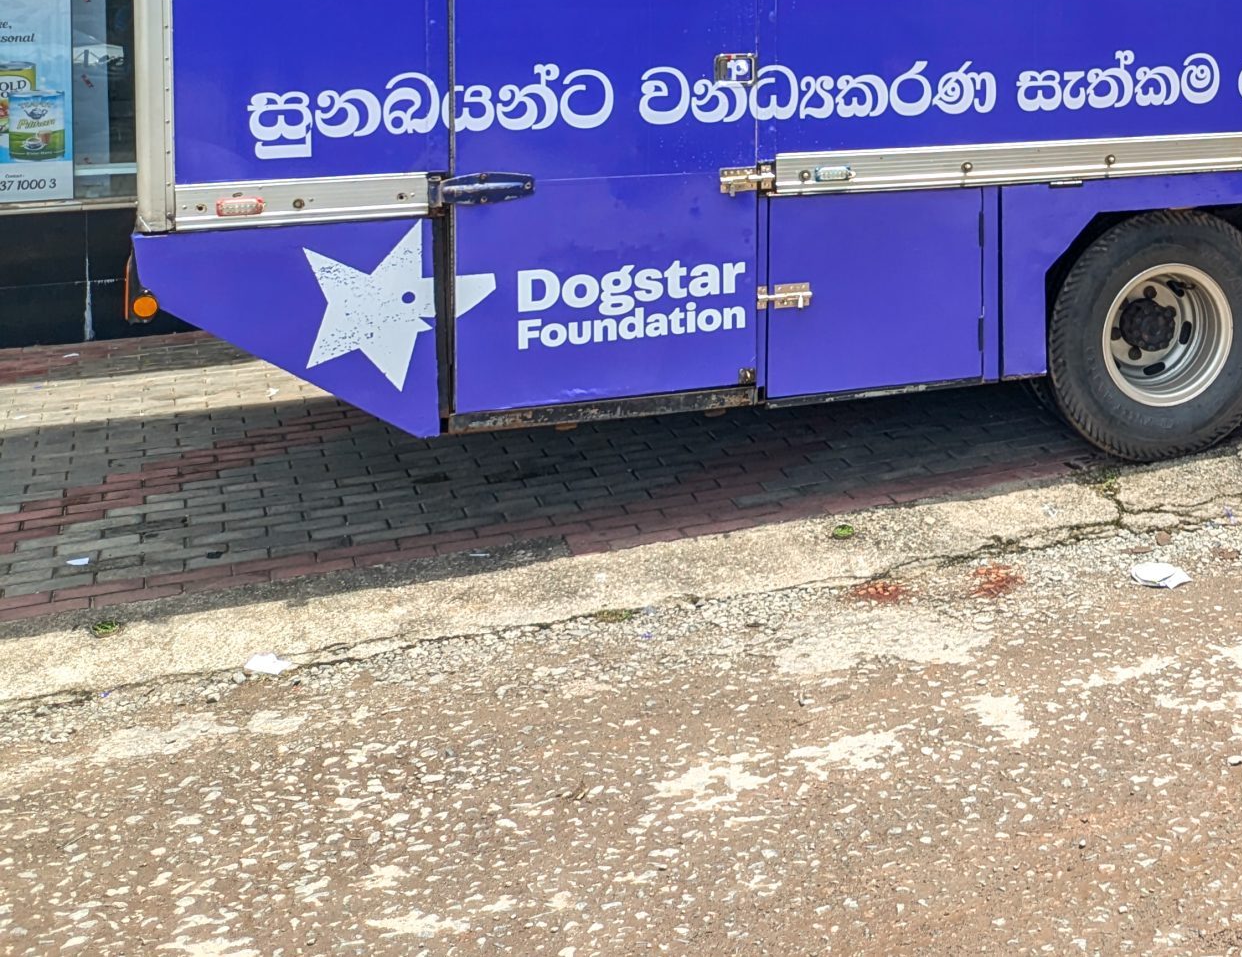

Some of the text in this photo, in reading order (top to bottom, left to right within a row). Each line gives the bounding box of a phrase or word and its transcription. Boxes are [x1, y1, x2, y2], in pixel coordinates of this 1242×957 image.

[247, 63, 614, 160] සුනඛයන්ට
[1016, 50, 1220, 112] සැත්කම
[17, 178, 46, 191] 1000
[49, 178, 57, 189] 3
[517, 260, 746, 316] Dogstar
[517, 302, 746, 350] Foundation
